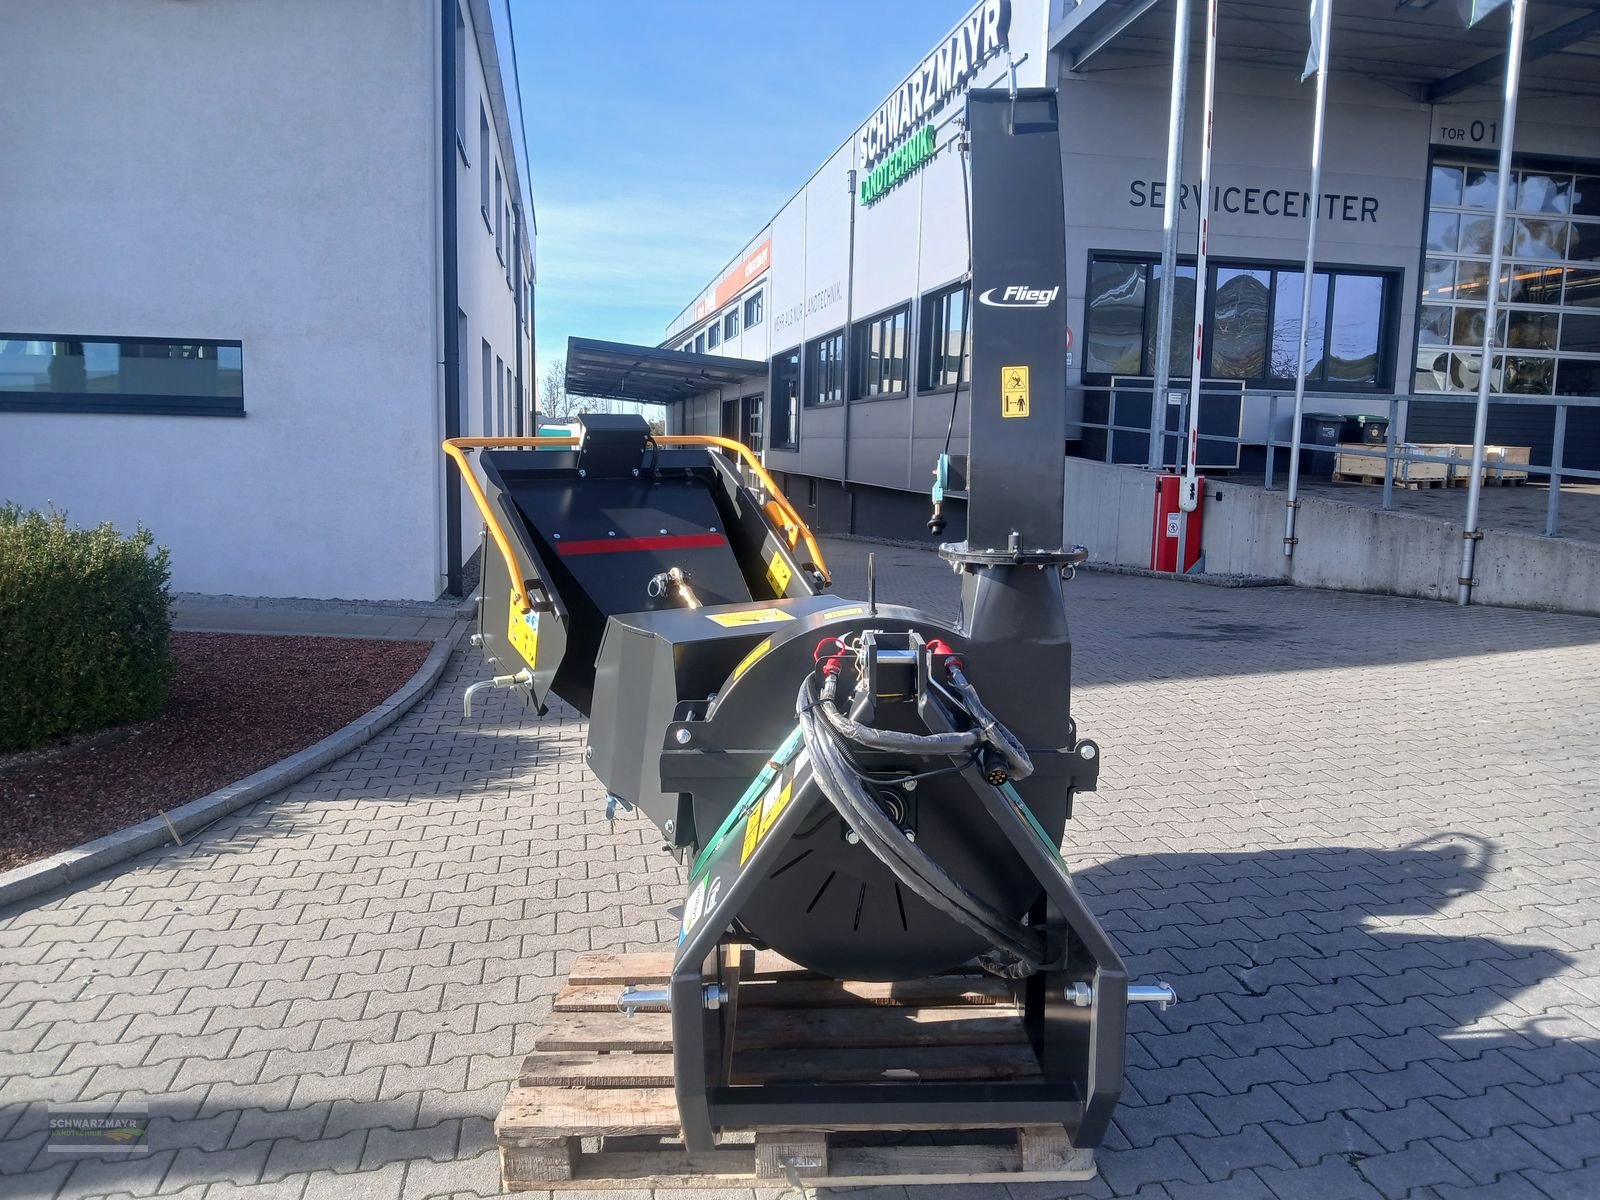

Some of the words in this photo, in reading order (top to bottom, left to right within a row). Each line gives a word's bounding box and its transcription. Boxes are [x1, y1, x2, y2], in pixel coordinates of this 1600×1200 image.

[860, 0, 1002, 169] SCHWARZMAYR
[1441, 127, 1465, 140] TOR
[1470, 120, 1497, 143] 01
[860, 124, 935, 206] LANDTECHNIK
[1002, 286, 1060, 305] Fliegl
